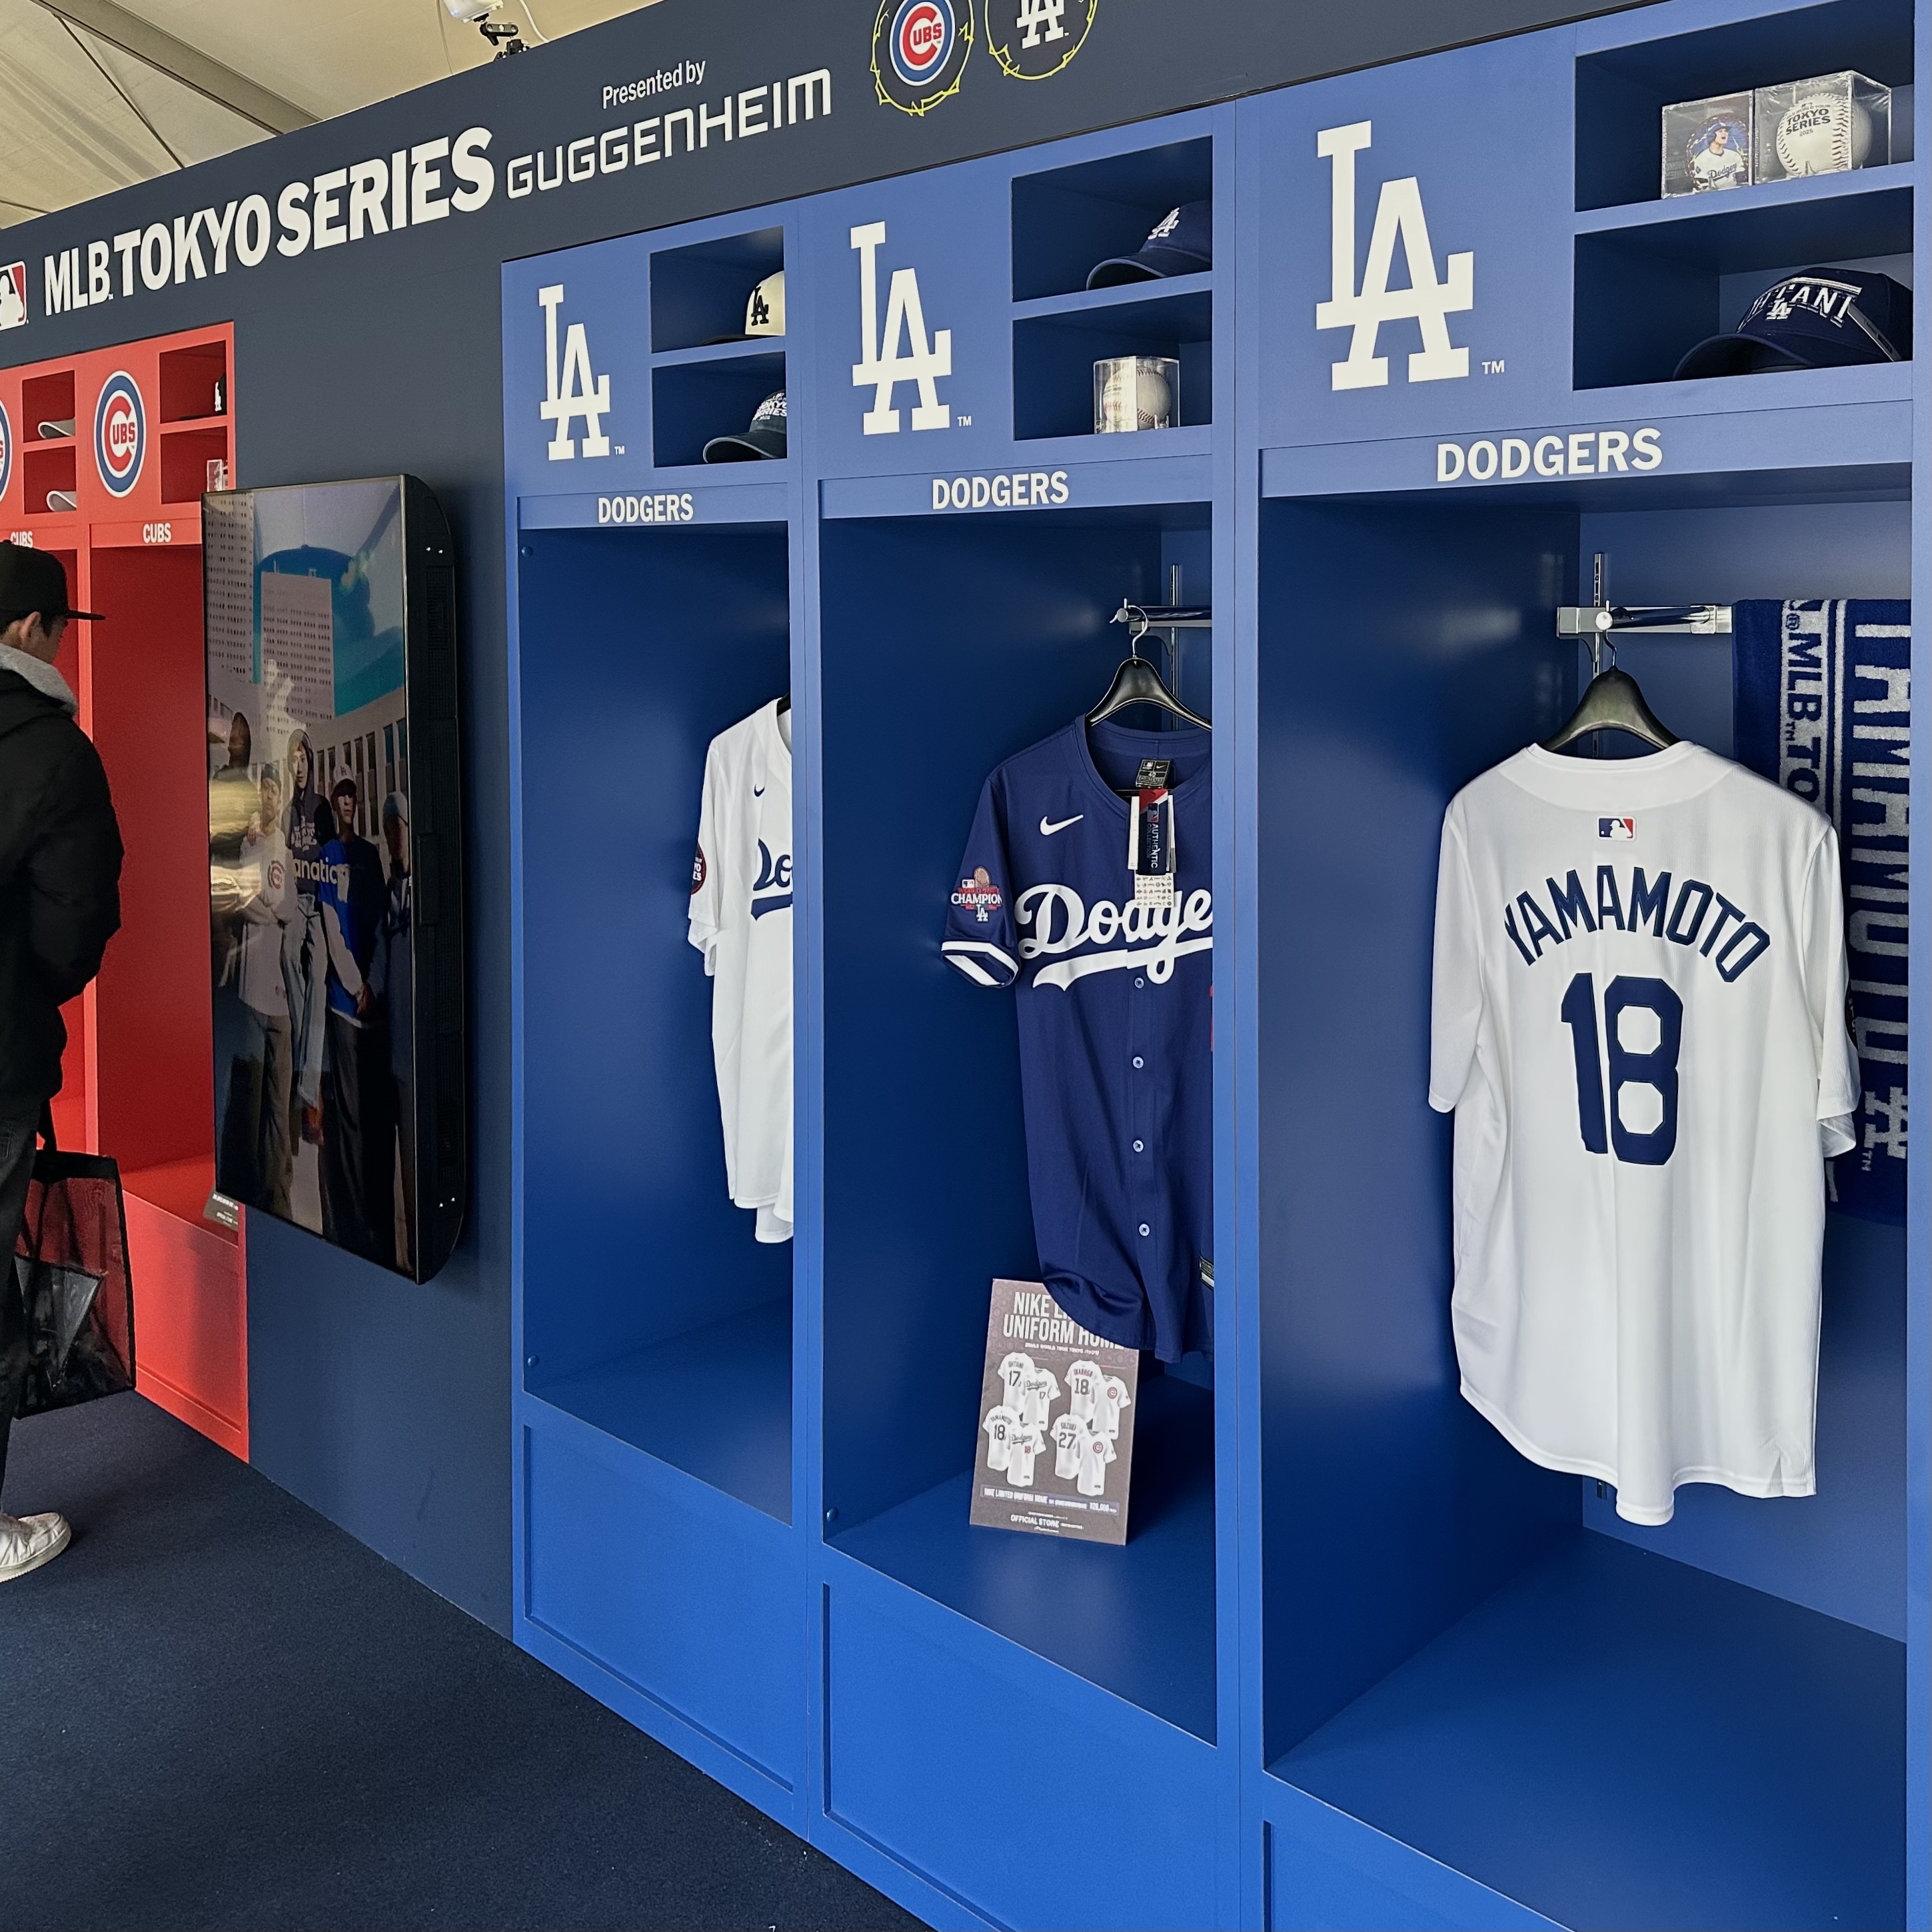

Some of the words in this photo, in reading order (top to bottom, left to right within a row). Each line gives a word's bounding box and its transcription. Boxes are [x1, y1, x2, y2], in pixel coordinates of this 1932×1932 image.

[602, 63, 682, 109] Presented
[686, 60, 706, 85] by
[507, 69, 831, 199] GUGGENHEIM
[1786, 115, 1831, 135] SERIES
[1787, 108, 1829, 125] TOKYO
[44, 241, 111, 316] MLB
[113, 194, 271, 297] TOKYO
[276, 127, 494, 257] SERIES
[1316, 121, 1473, 391] LA
[751, 287, 769, 326] LA
[850, 221, 951, 435] LA
[539, 284, 610, 461] LA
[1437, 428, 1663, 481] DODGERS
[598, 493, 694, 523] DODGERS
[932, 471, 1069, 509] DODGERS
[143, 522, 171, 543] CUBS
[1788, 632, 1823, 722] MLB
[1151, 824, 1160, 868] AUTHENTIC
[976, 904, 988, 922] LA
[1504, 865, 1770, 982] YAMAMOTO
[1561, 972, 1683, 1165] 18
[1014, 1292, 1051, 1318] NIKE
[1003, 1314, 1075, 1344] UNIFORM
[1078, 1326, 1124, 1350] HO
[1010, 1370, 1020, 1387] 17
[1039, 1392, 1046, 1400] 17
[1074, 1378, 1089, 1396] 18
[994, 1424, 1006, 1441] 18
[1058, 1432, 1076, 1449] 27
[1010, 1514, 1038, 1525] OFFICIAL
[1039, 1517, 1060, 1528] STORE
